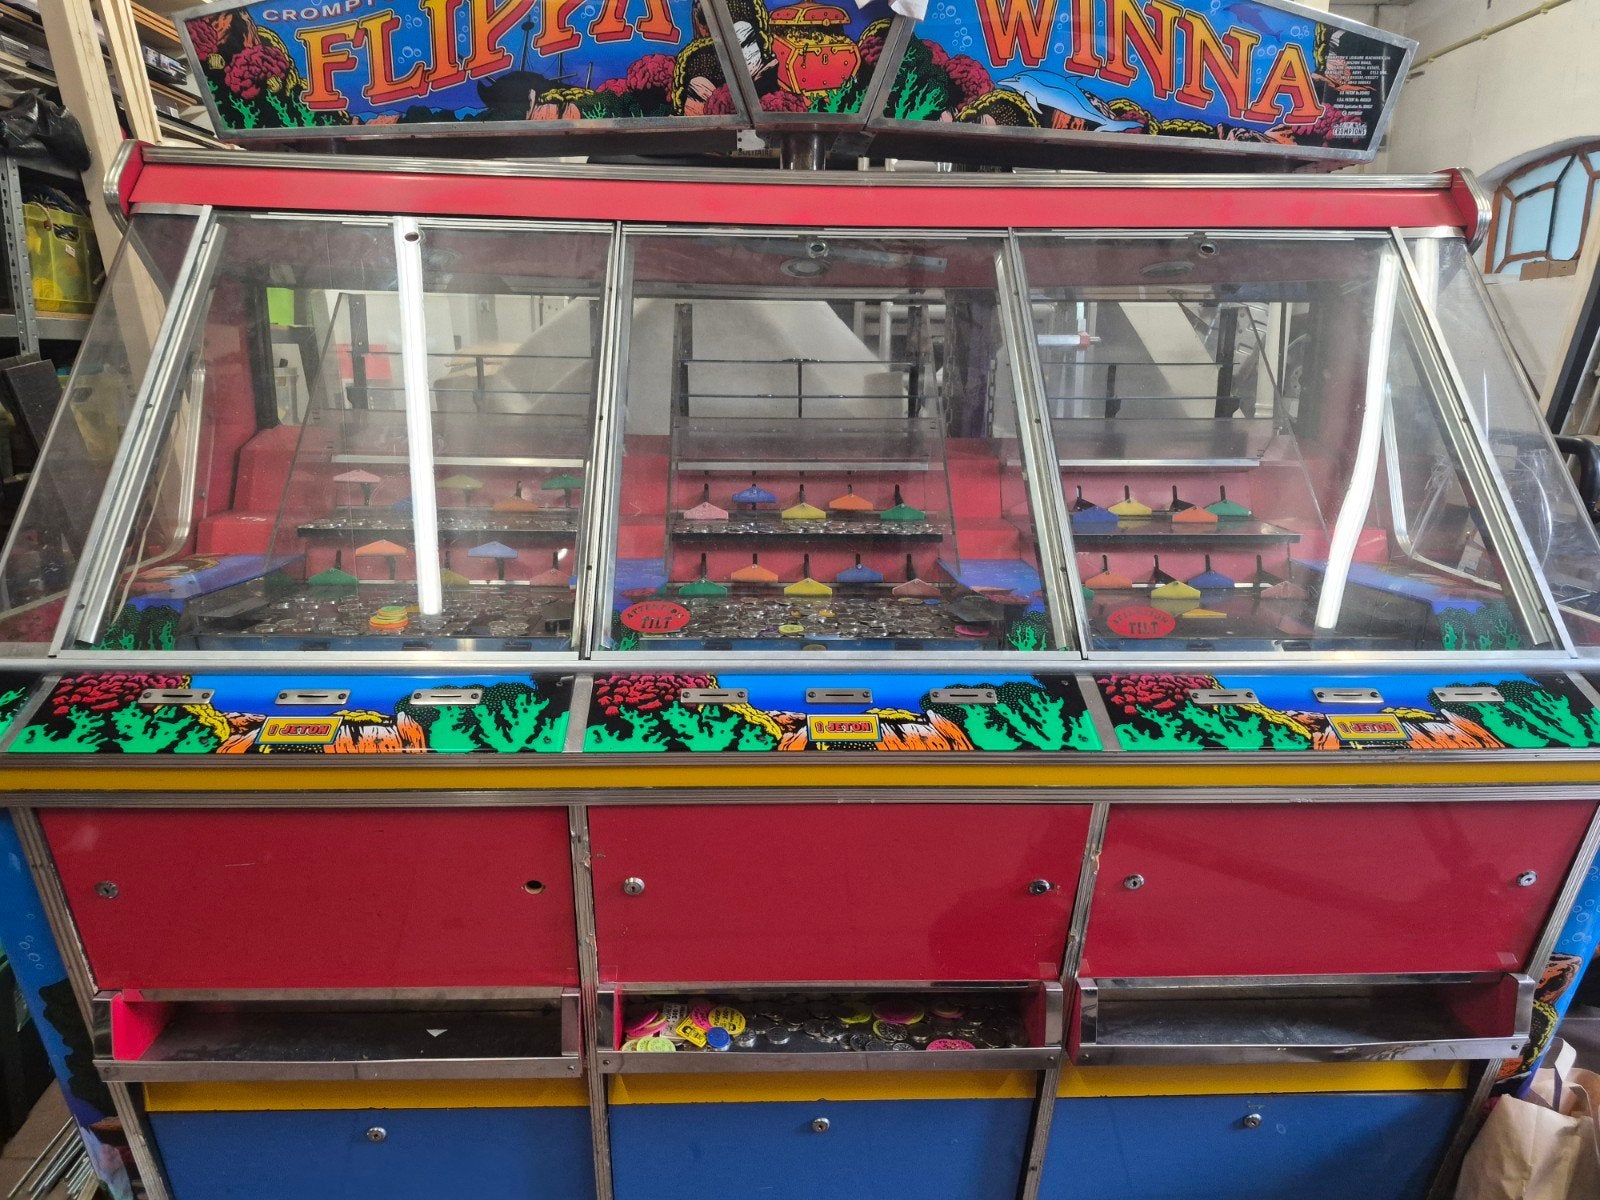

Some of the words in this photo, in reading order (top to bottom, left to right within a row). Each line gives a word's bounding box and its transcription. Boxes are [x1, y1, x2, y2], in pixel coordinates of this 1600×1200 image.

[976, 0, 1325, 125] WINNA
[641, 616, 672, 629] TILT
[1128, 621, 1158, 635] TILT
[279, 724, 331, 736] JETON
[826, 721, 873, 733] JETON
[1350, 722, 1399, 733] JETON
